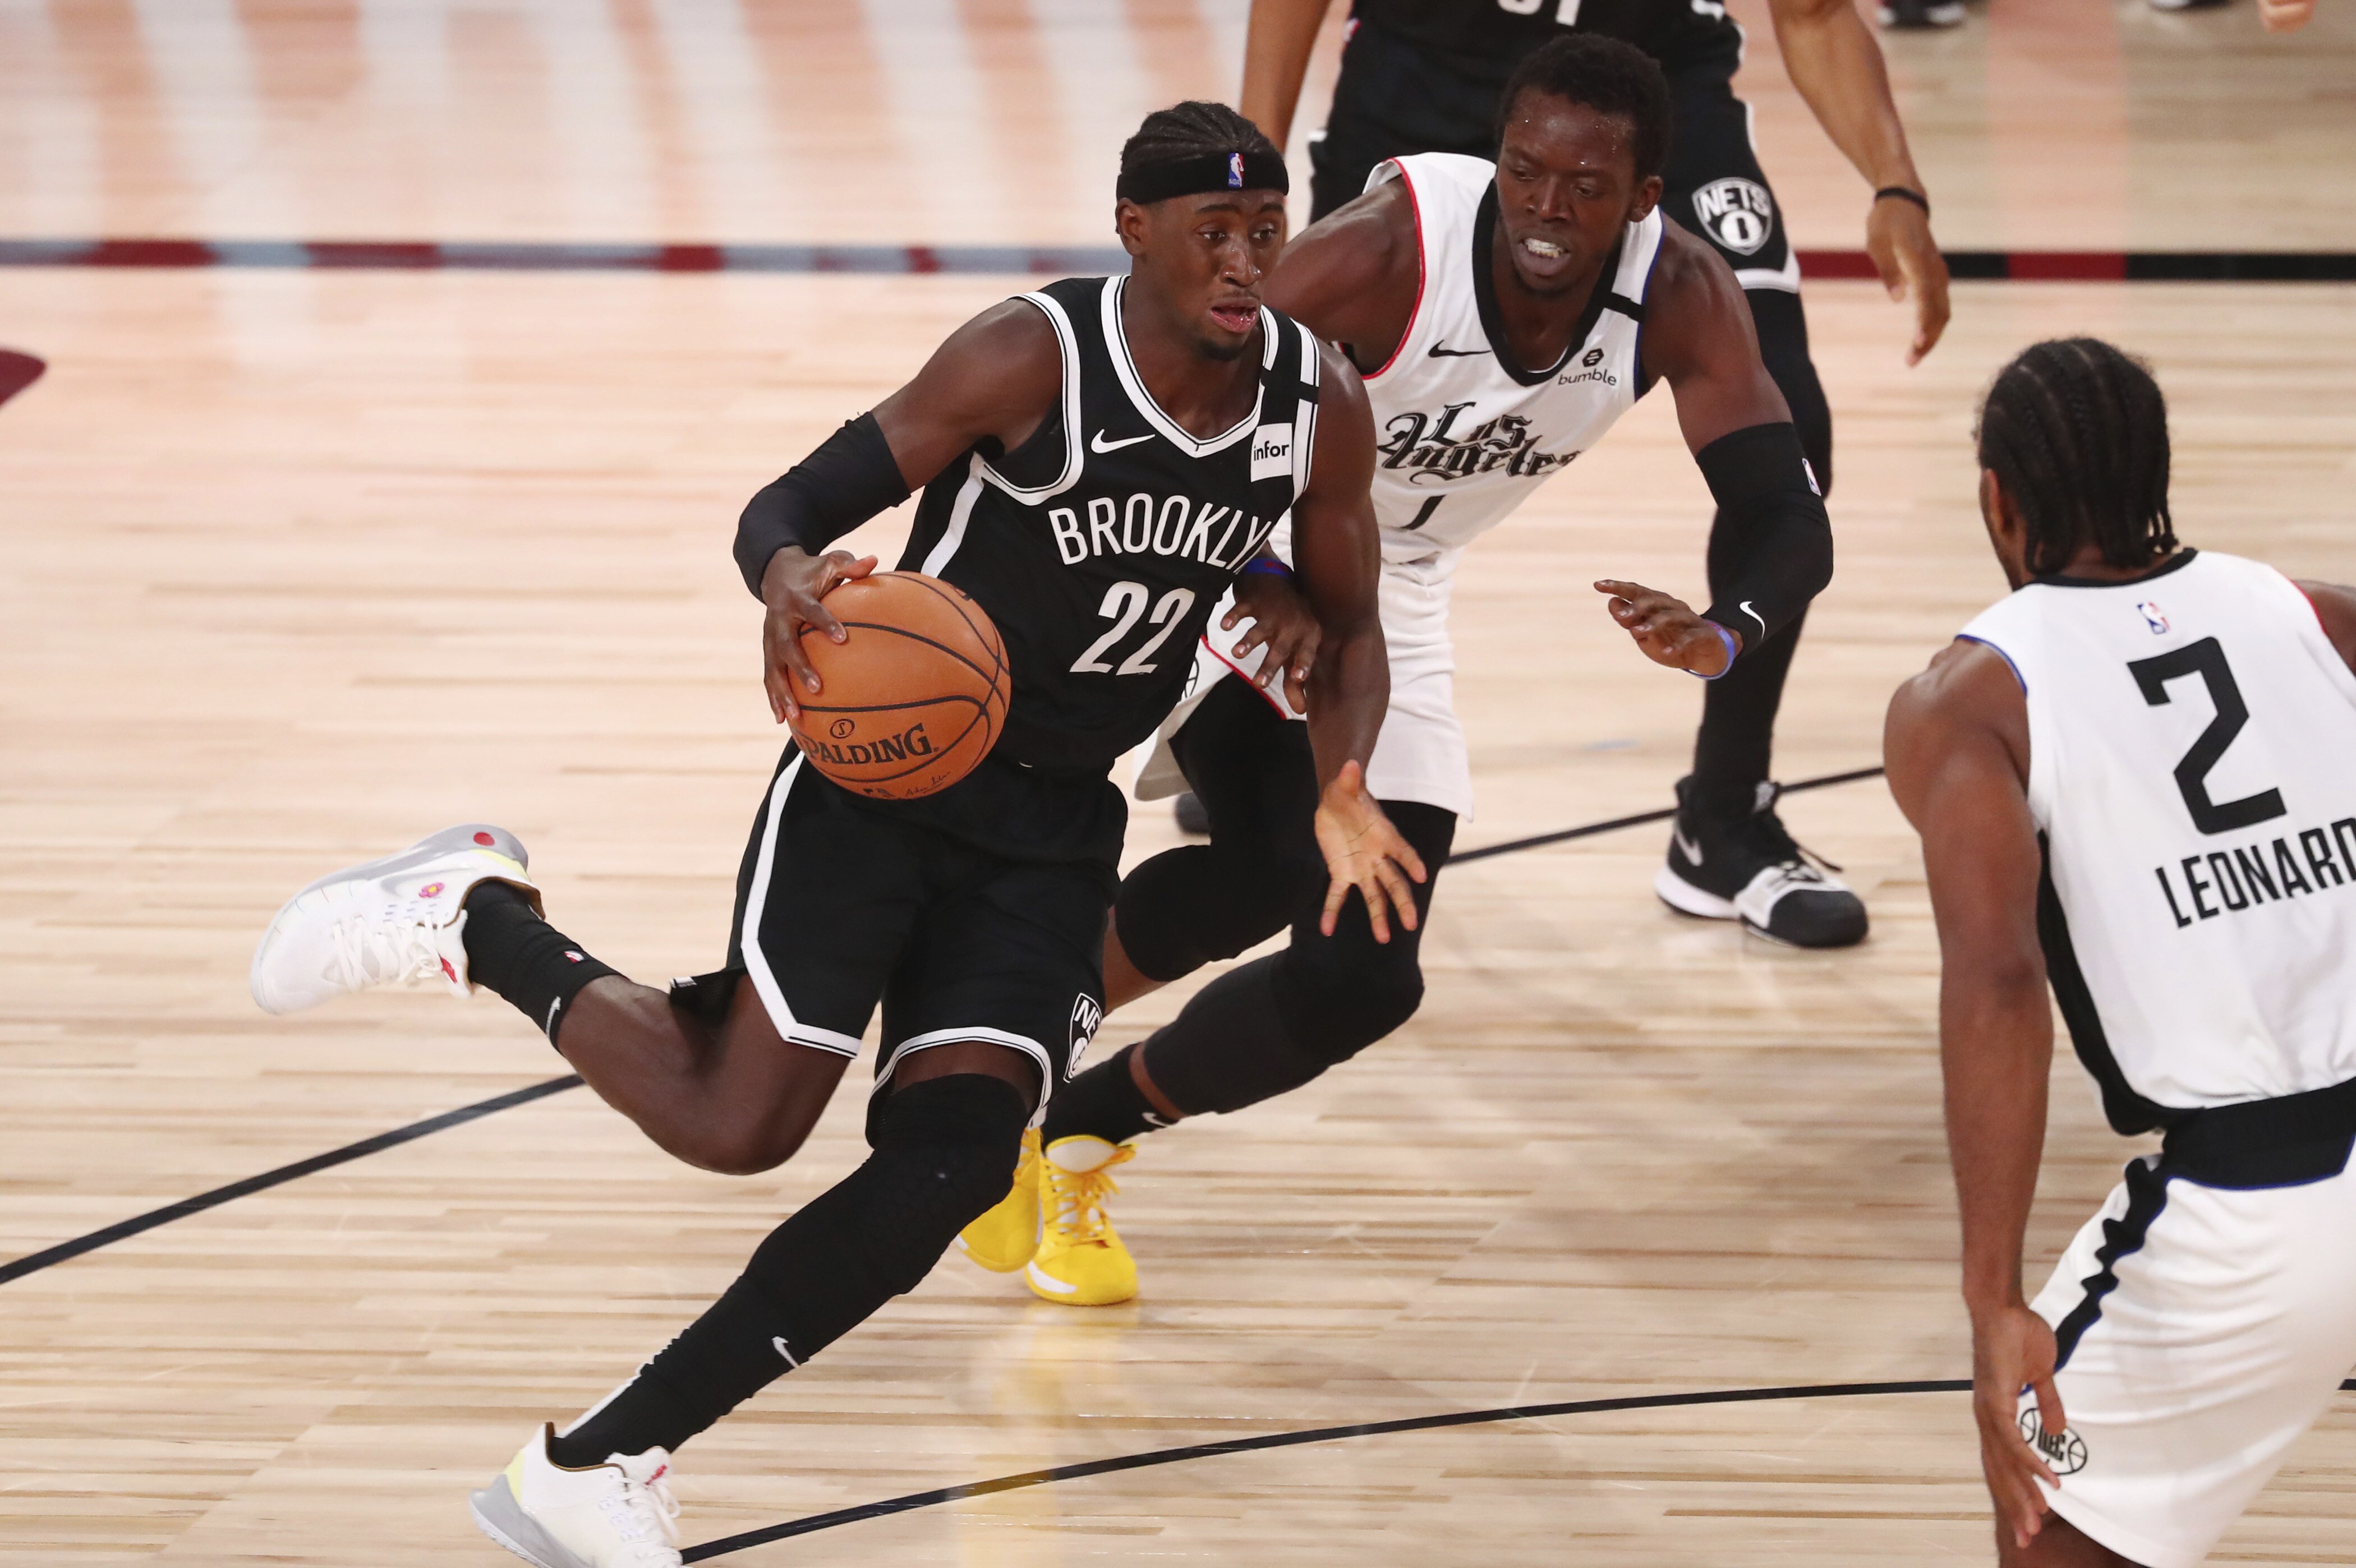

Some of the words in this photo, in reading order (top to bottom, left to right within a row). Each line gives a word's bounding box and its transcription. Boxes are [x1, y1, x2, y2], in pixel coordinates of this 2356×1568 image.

[1699, 183, 1769, 222] NETS
[1558, 368, 1617, 386] bumble
[1421, 402, 1533, 449] Los
[1254, 440, 1290, 462] infor
[1048, 493, 1276, 574] BROOKLY
[1069, 580, 1195, 676] 22
[793, 722, 932, 764] PALDING
[2126, 636, 2288, 836] 2
[2155, 818, 2356, 929] LEONARD
[1074, 999, 1101, 1041] NE
